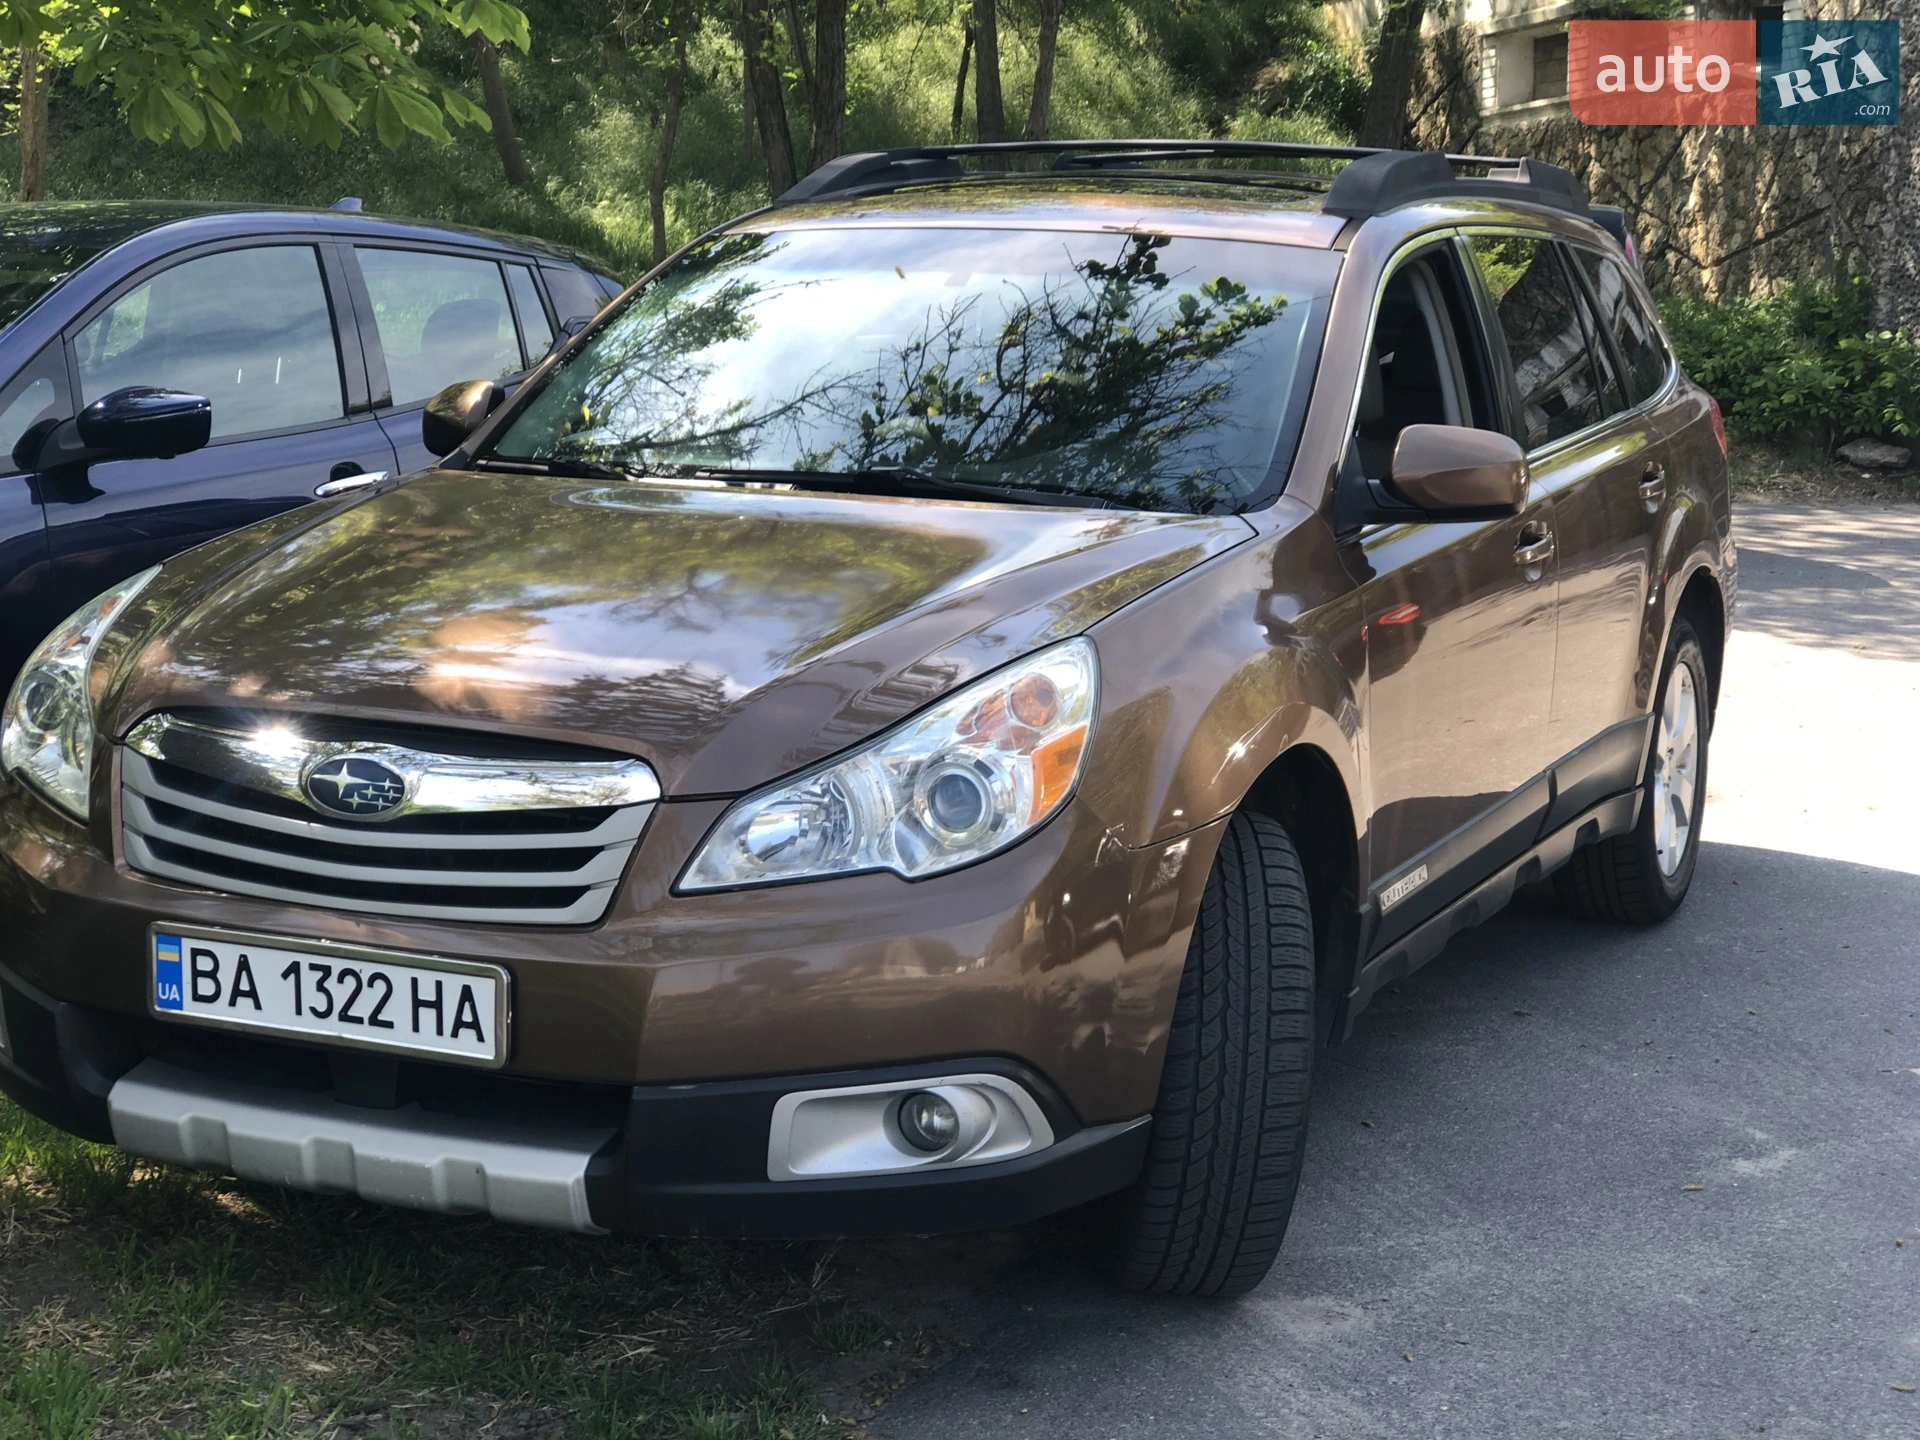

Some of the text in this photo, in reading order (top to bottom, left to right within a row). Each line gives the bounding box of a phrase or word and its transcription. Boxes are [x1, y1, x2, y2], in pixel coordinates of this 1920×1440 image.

[158, 983, 181, 1001] UA
[190, 947, 485, 1043] BA 1322 HA
